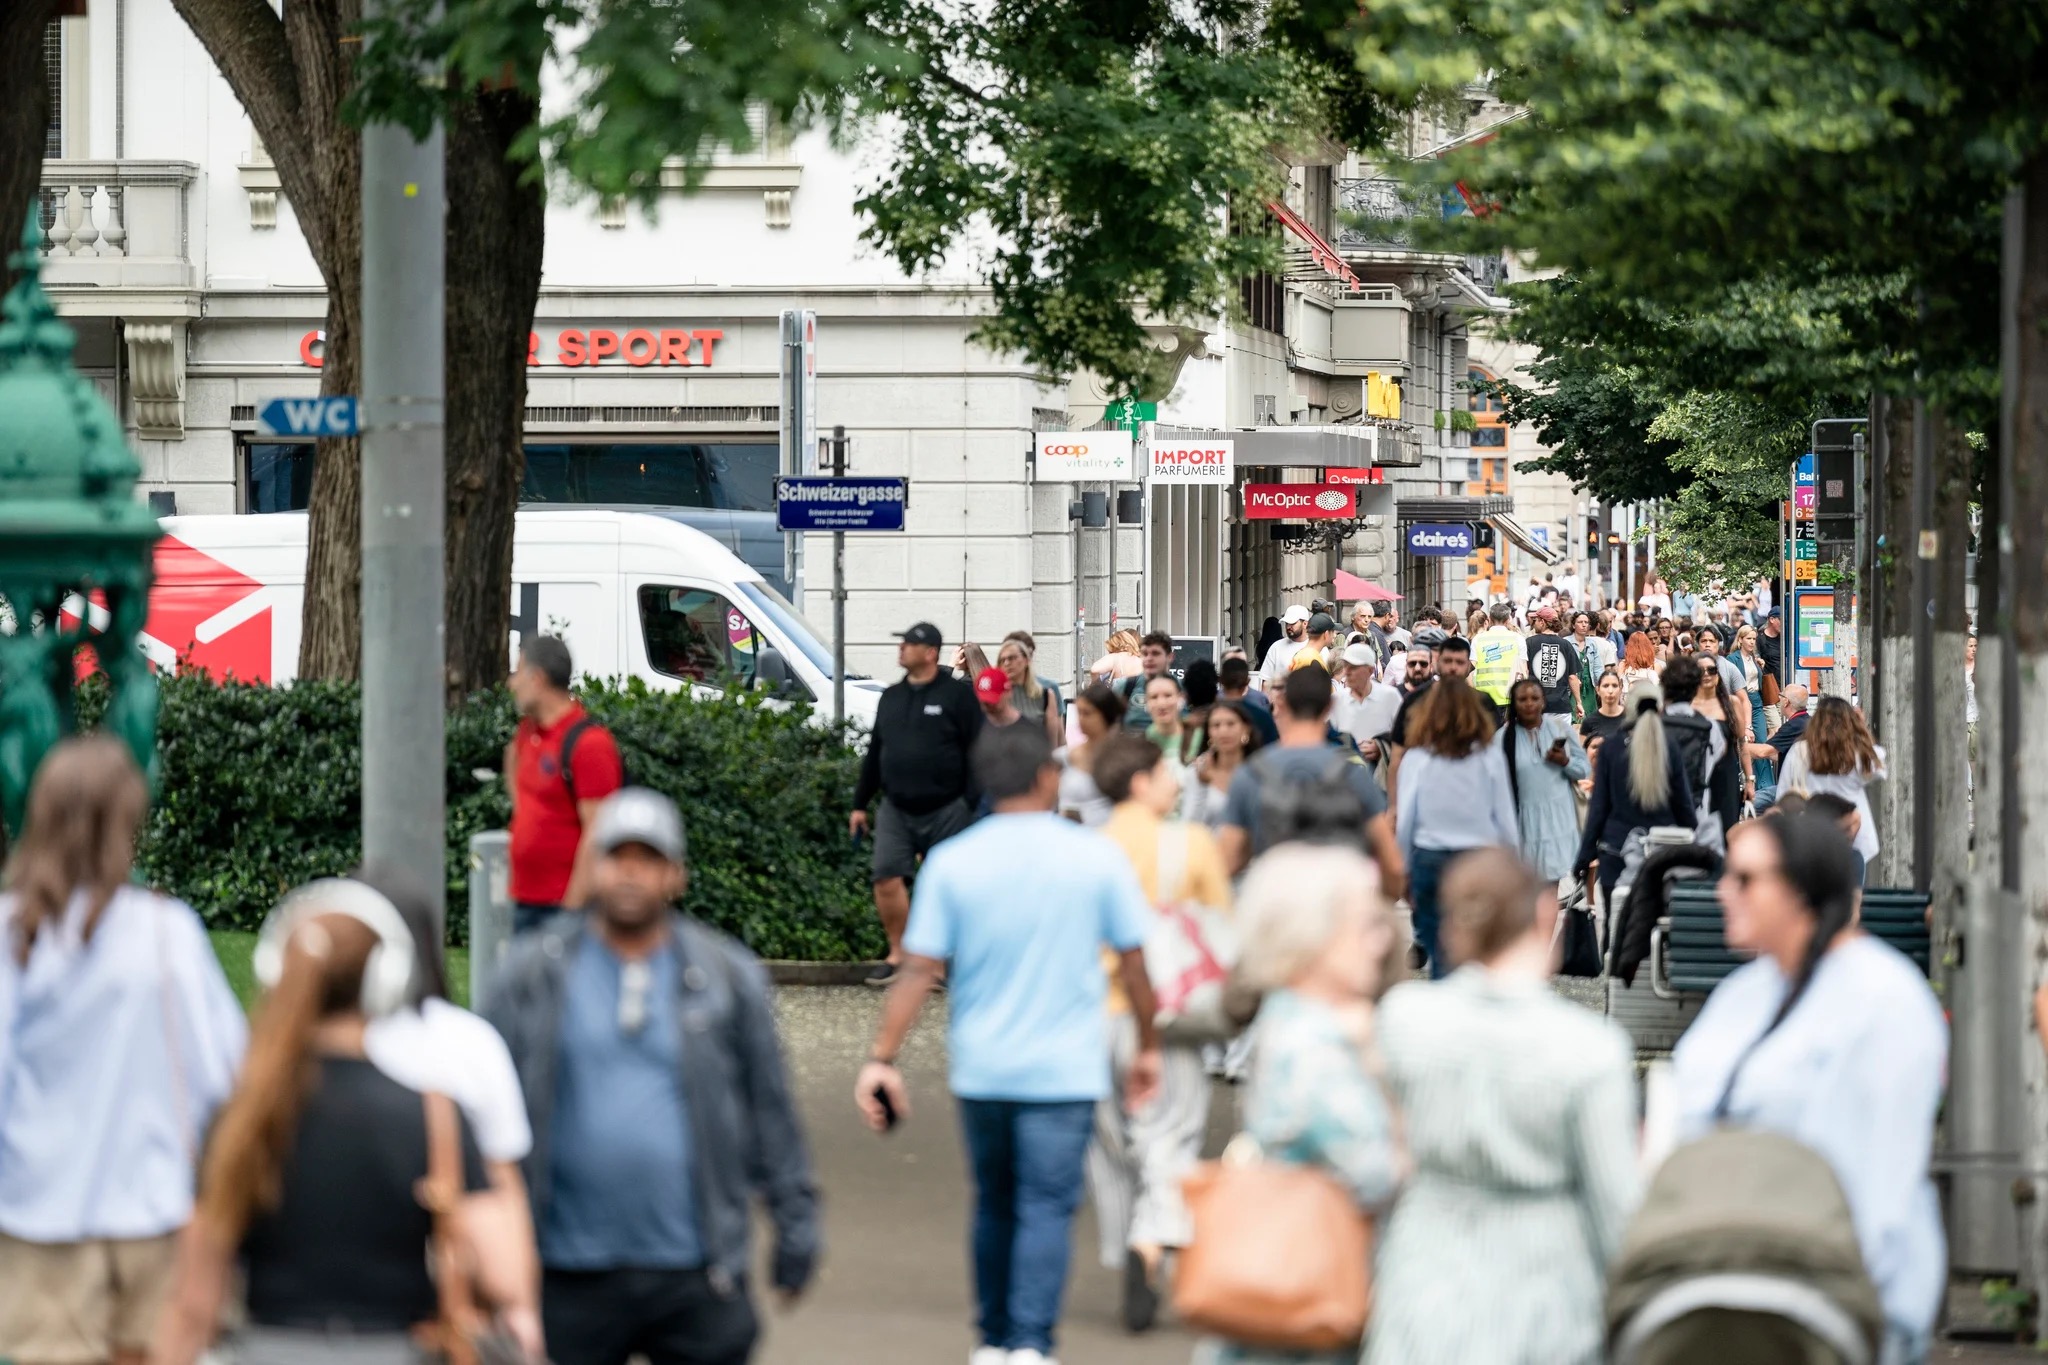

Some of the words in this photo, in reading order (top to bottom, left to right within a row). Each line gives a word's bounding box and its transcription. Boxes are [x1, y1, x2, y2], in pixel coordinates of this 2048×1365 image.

[558, 329, 723, 367] SPORT
[282, 400, 350, 433] WC
[1044, 444, 1088, 458] coop
[1155, 450, 1226, 465] IMPORT
[1066, 457, 1110, 468] vitality
[1155, 465, 1226, 476] PARFUMERIE
[1341, 475, 1380, 485] Sunrie
[779, 482, 903, 506] Schweizergasse
[1252, 492, 1311, 509] McOptic
[1802, 494, 1815, 506] 17
[1796, 508, 1803, 518] 6
[1411, 531, 1469, 548] claire's
[1796, 528, 1804, 538] 7
